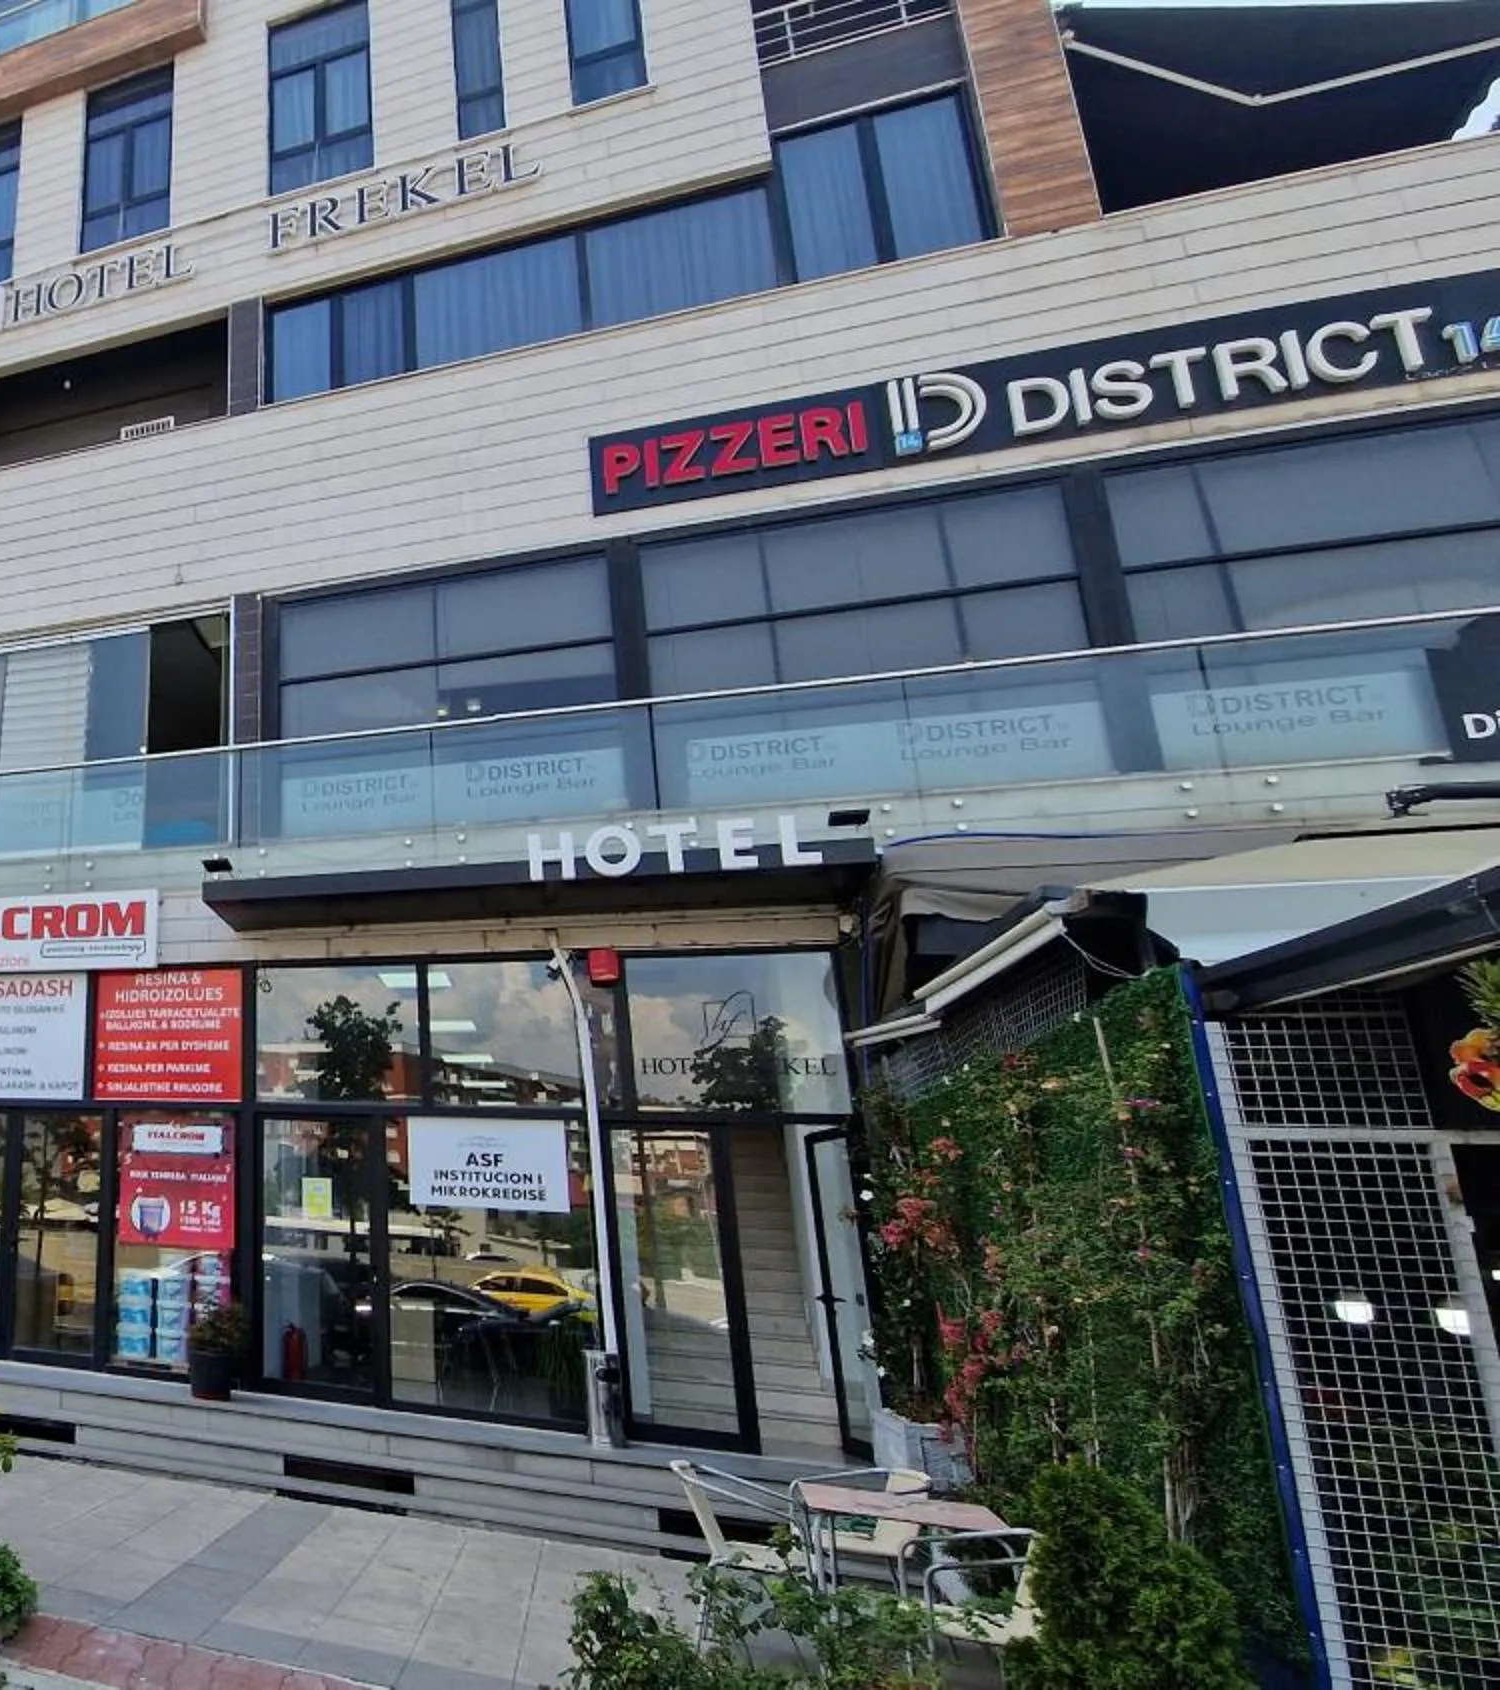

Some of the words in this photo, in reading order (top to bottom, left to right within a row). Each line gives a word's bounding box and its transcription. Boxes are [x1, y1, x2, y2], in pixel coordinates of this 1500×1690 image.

[7, 242, 196, 324] HOTEL
[267, 143, 543, 256] FREKEL
[1007, 306, 1433, 438] DISTRICT
[602, 401, 870, 495] PIZZERI
[1219, 684, 1366, 716] DISTRICT
[926, 713, 1054, 742] DISTRICT
[1192, 714, 1317, 737] Lounge
[1328, 707, 1388, 725] Bar
[710, 735, 823, 762] DISTRICT
[900, 742, 1007, 761] Lounge
[1020, 736, 1072, 752] Bar
[488, 757, 584, 782] DISTRICT
[321, 774, 409, 797] DISTRICT
[526, 814, 824, 881] HOTEL
[135, 971, 189, 987] RESINA
[190, 973, 203, 986] &
[114, 986, 224, 1004] HIDROIZOLUES
[145, 1063, 165, 1073] PER
[465, 1151, 505, 1168] ASF
[433, 1168, 534, 1186] INSTITUCION
[180, 1200, 198, 1215] 15
